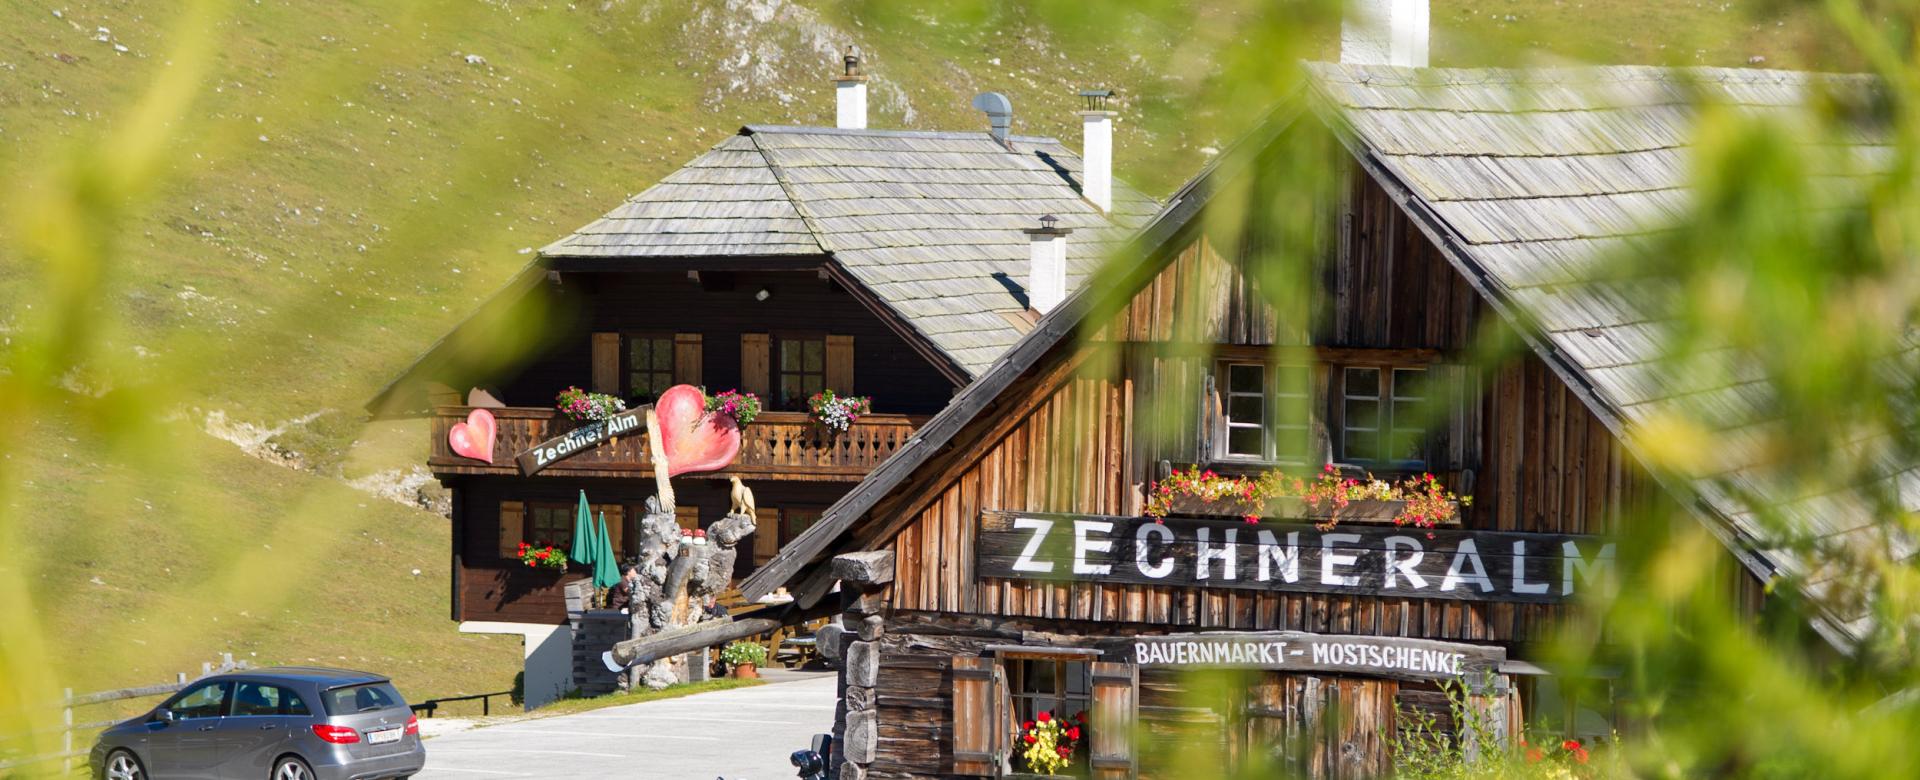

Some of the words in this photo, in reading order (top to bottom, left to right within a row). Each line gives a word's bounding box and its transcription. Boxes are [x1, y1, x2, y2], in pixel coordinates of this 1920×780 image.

[533, 425, 603, 465] Zechner
[607, 414, 638, 436] Alm
[1012, 518, 1617, 598] ZECHNERALM
[1135, 642, 1287, 665] BAUERNMARKT
[1312, 642, 1466, 676] MOSTSCHENKE
